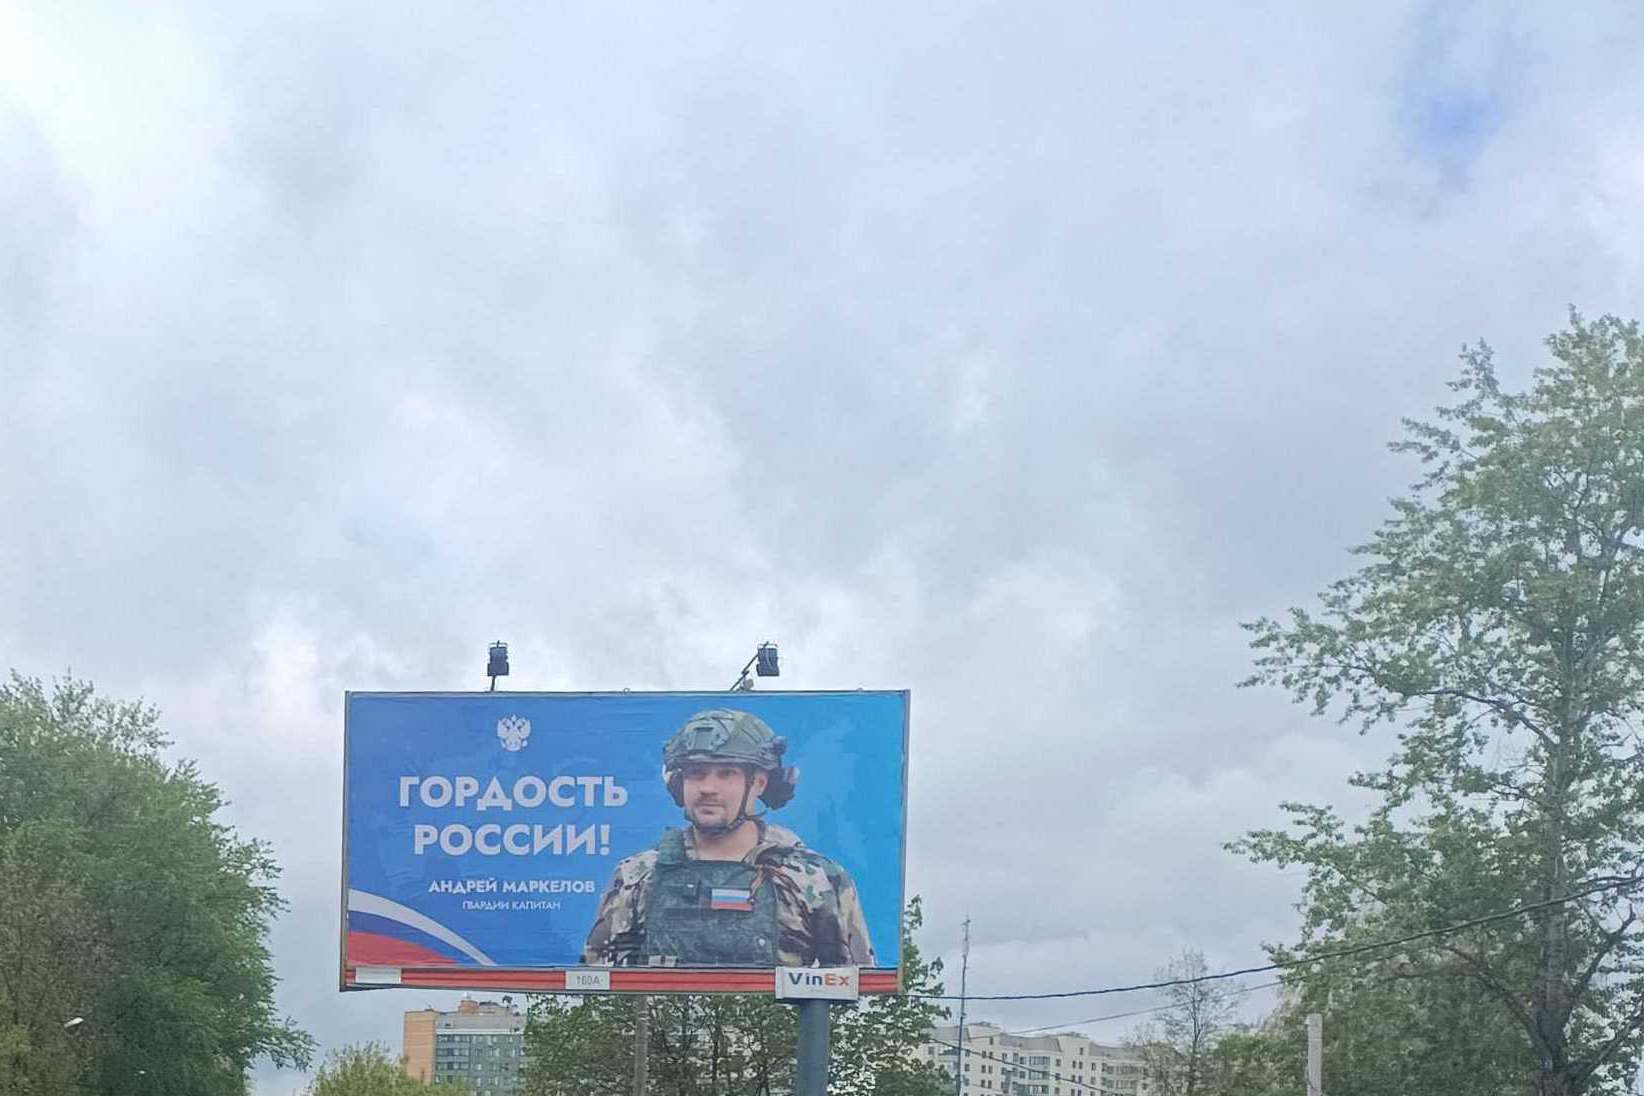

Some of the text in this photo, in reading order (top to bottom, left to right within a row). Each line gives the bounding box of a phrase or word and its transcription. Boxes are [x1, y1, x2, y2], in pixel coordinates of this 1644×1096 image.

[399, 775, 628, 811] ГОРДОСТЬ
[414, 824, 610, 856] РОССИИ!
[428, 877, 596, 894] АНДРЕЙ МАРКЕЛОВ
[462, 900, 561, 911] ГВАРДИИ КАПИТАН
[788, 972, 850, 986] VinEx
